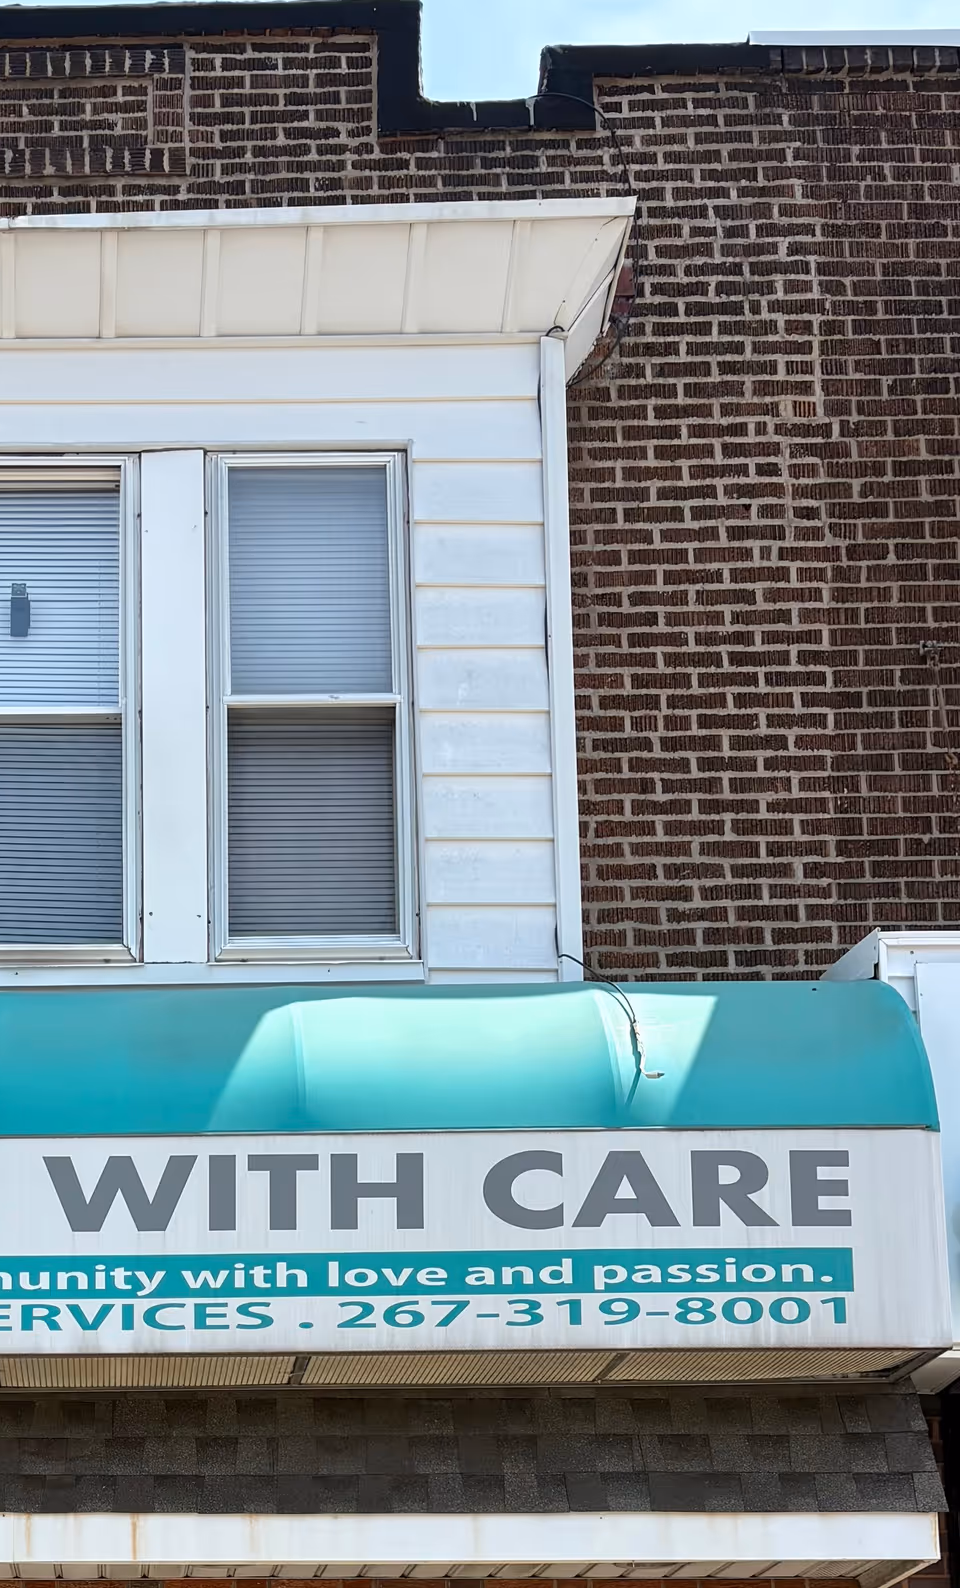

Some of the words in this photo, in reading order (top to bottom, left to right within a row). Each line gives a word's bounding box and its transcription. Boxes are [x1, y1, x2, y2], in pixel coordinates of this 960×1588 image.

[42, 1153, 425, 1233] WITH
[482, 1149, 853, 1231] CARE
[181, 1261, 309, 1289] with
[327, 1259, 448, 1287] love
[464, 1258, 573, 1285] and
[593, 1256, 835, 1291] passion.
[337, 1296, 848, 1329] 267-319-8001
